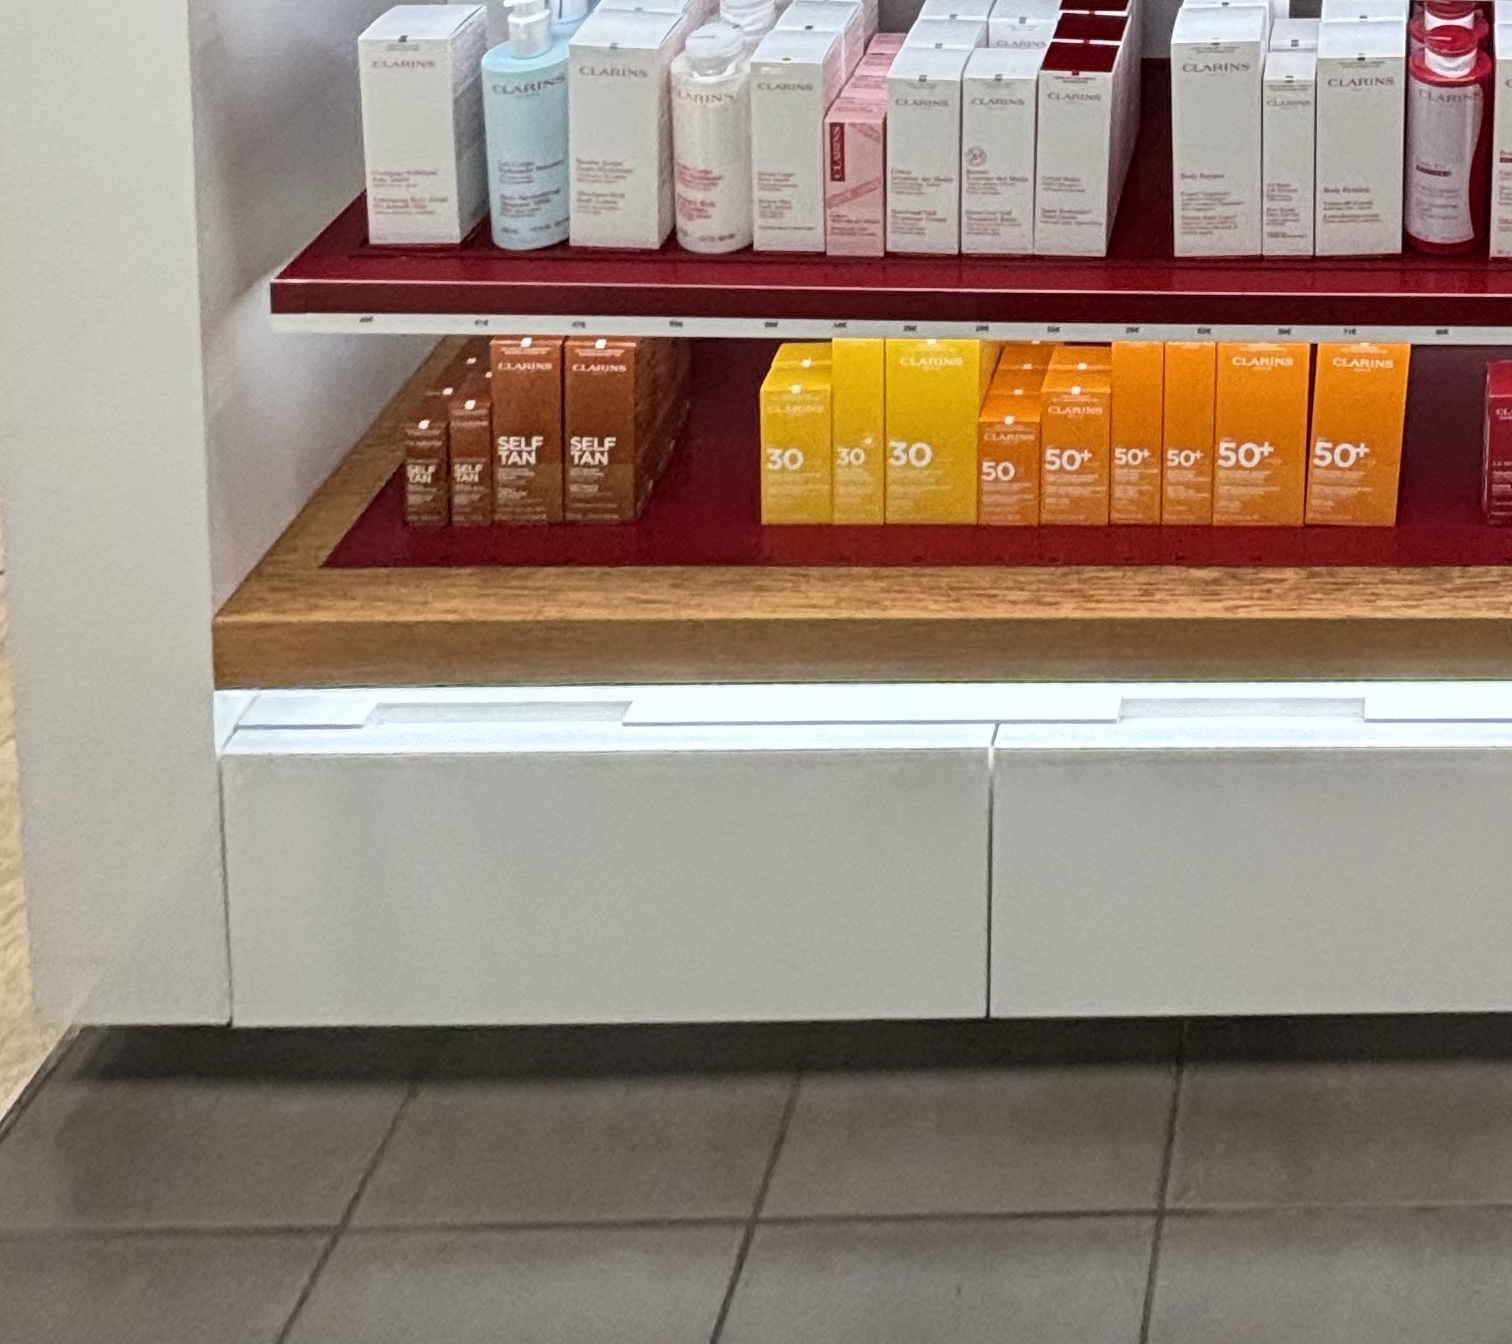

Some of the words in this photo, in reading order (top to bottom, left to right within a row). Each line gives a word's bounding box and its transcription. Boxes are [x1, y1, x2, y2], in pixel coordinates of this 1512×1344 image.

[580, 67, 649, 78] CLARINS
[1182, 62, 1250, 73] CLARINS
[493, 75, 566, 95] CLARINS
[758, 82, 813, 92] CLARINS
[1328, 77, 1394, 88] CLARINS
[1047, 92, 1101, 102] CLARINS
[498, 362, 552, 370] CLARINS
[900, 356, 963, 366] CLARINS
[1231, 356, 1294, 367] CLARINS
[1332, 357, 1394, 369] CLARINS
[572, 364, 627, 373] CLARINS
[498, 436, 544, 451] SELF
[570, 437, 617, 451] SELF
[499, 451, 537, 466] TAN
[570, 451, 610, 466] TAN
[767, 448, 804, 470] 30
[837, 448, 865, 465] 30
[888, 441, 933, 468] 30
[1044, 447, 1092, 471] 50+
[1113, 447, 1151, 466] 50+
[1166, 449, 1204, 468] 50+
[1217, 440, 1274, 468] 50+
[1313, 440, 1370, 468] 50+
[406, 464, 436, 475] SELF
[454, 464, 483, 474] SELF
[981, 461, 1015, 482] 50
[408, 473, 432, 484] TAN
[455, 472, 480, 483] TAN
